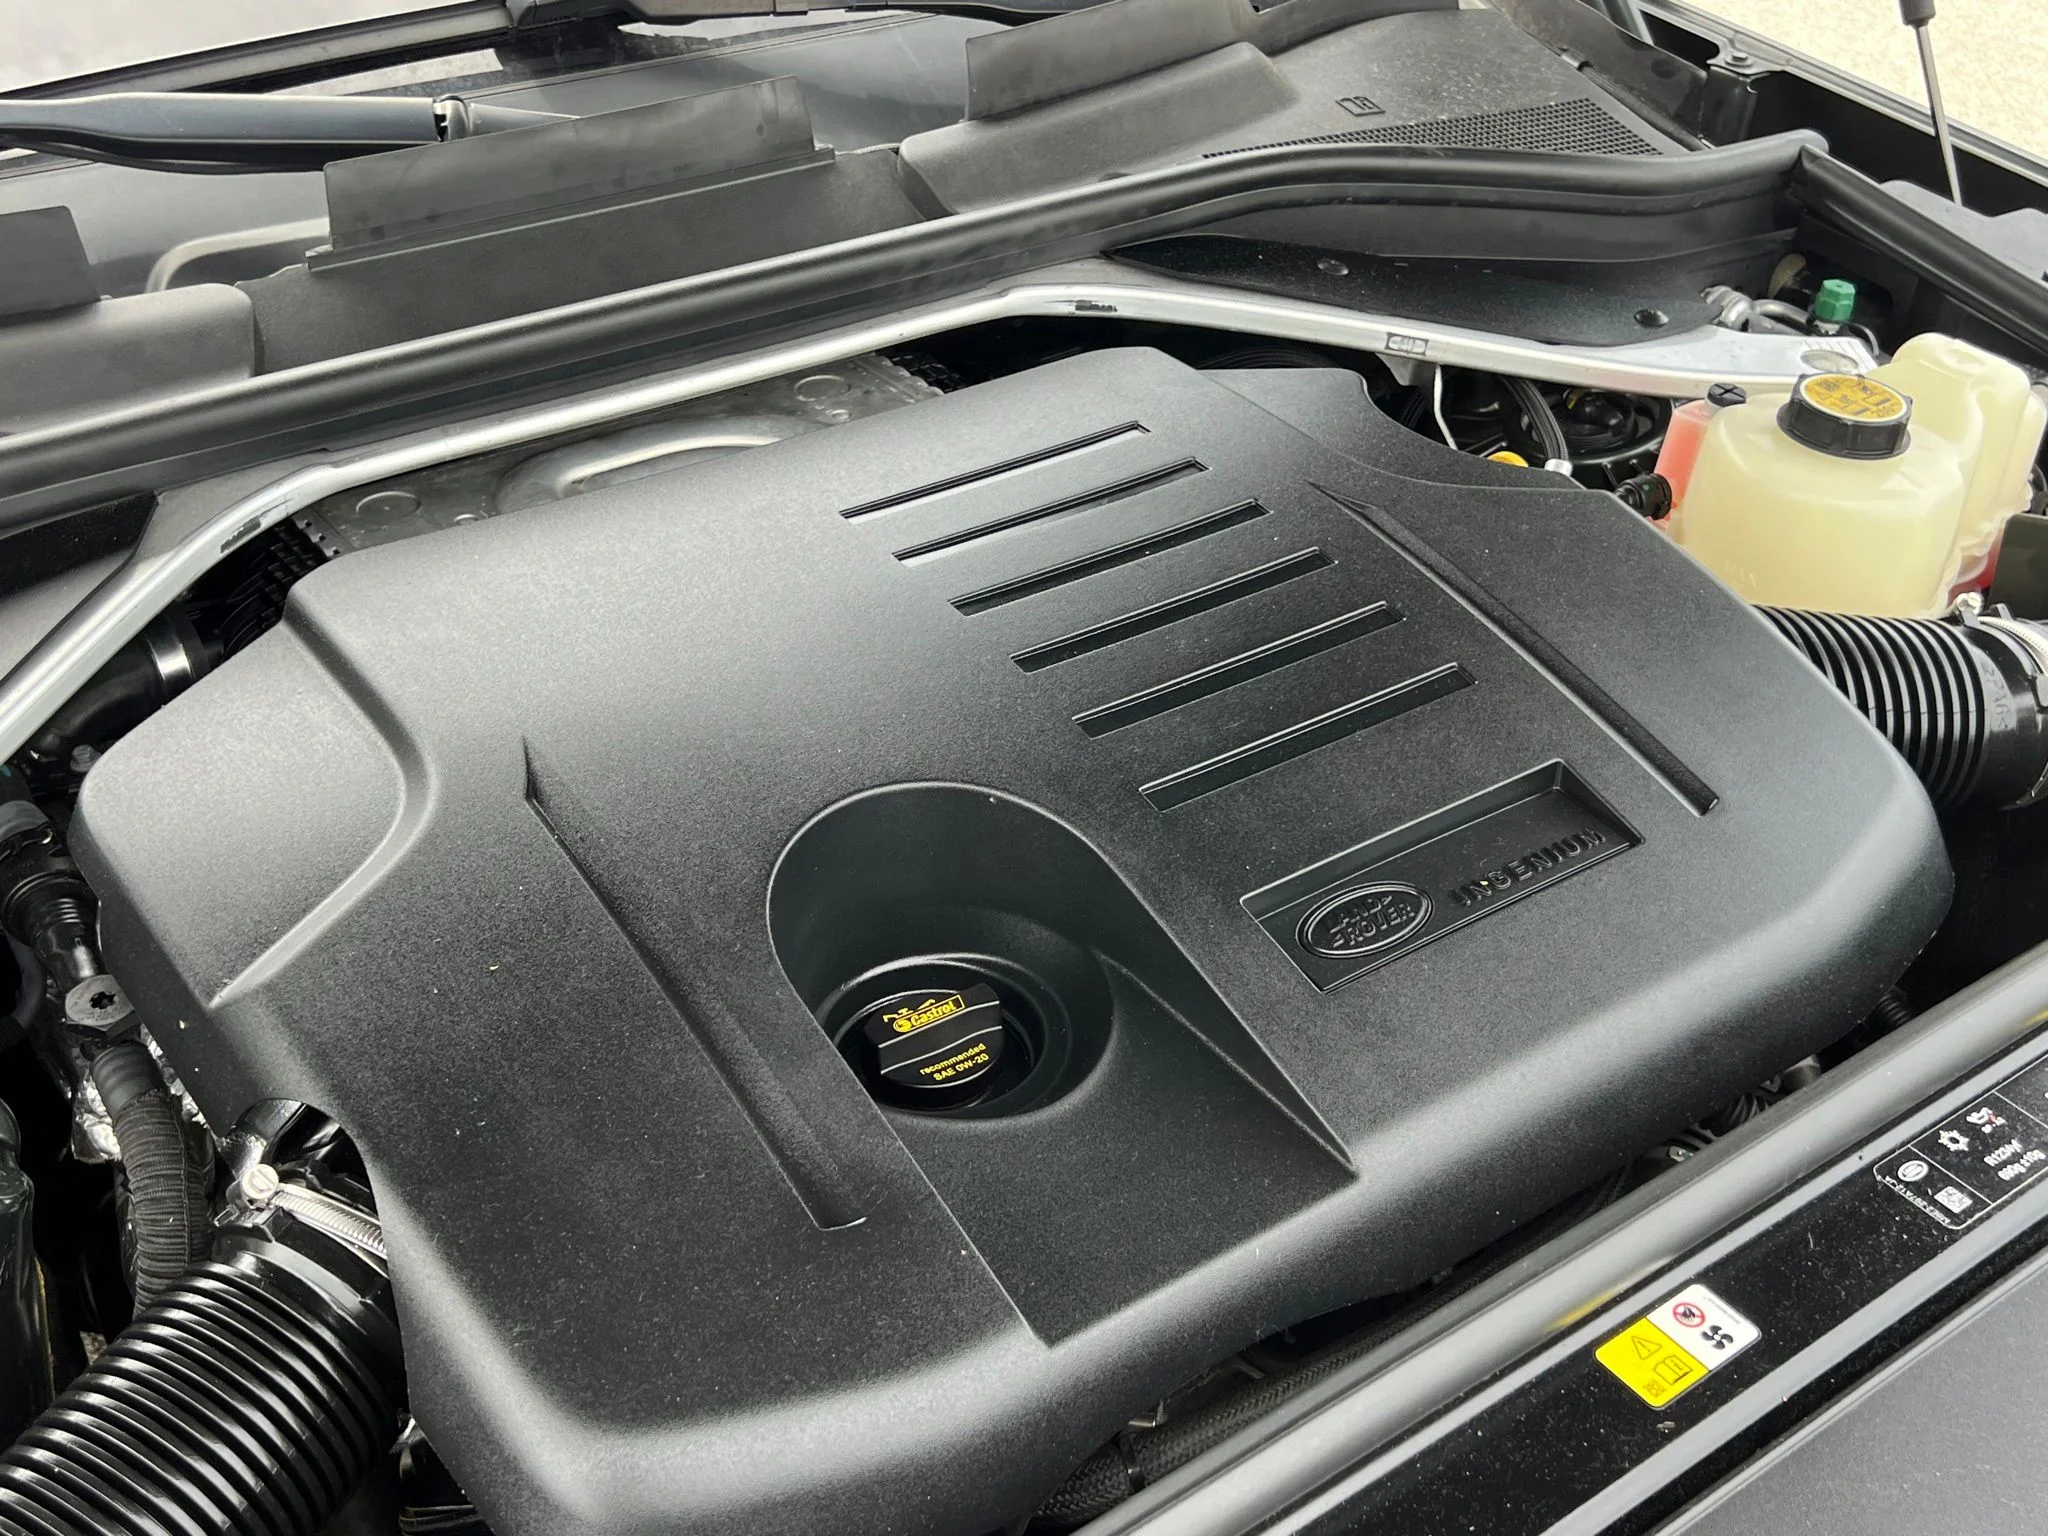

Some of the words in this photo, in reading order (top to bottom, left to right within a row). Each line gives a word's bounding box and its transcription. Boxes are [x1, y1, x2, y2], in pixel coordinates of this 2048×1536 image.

[1448, 827, 1606, 906] INGENIUM
[1345, 903, 1416, 946] ROVER
[911, 1001, 956, 1025] Castrol
[920, 1043, 986, 1075] recommended
[933, 1068, 955, 1081] SAE
[956, 1053, 989, 1072] 0W-20
